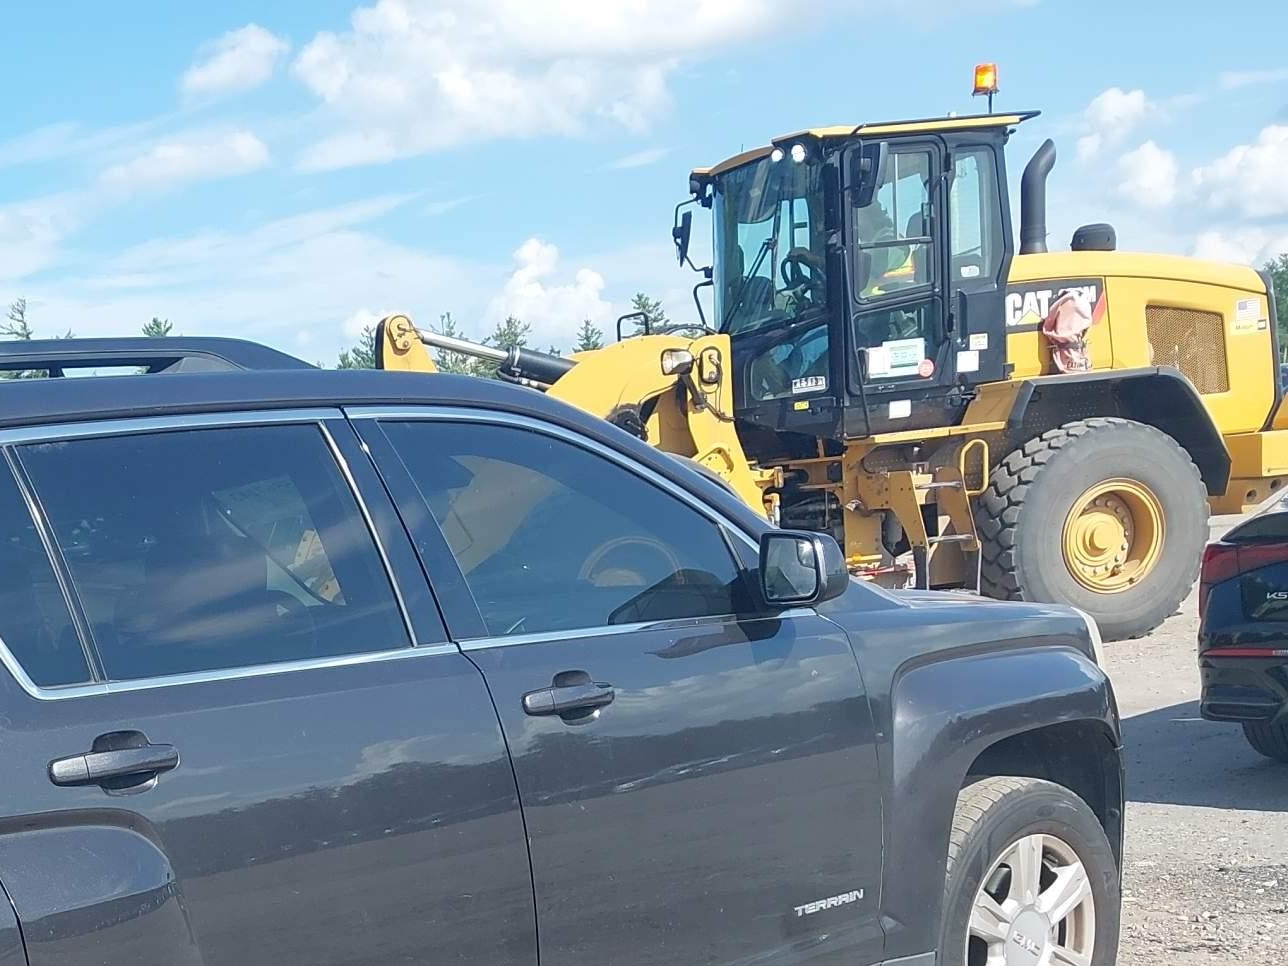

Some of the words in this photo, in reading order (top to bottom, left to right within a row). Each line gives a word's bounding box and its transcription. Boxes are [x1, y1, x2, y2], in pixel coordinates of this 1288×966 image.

[1005, 288, 1052, 326] CAT
[794, 888, 865, 917] TERRAIN
[1012, 930, 1041, 957] GMC
